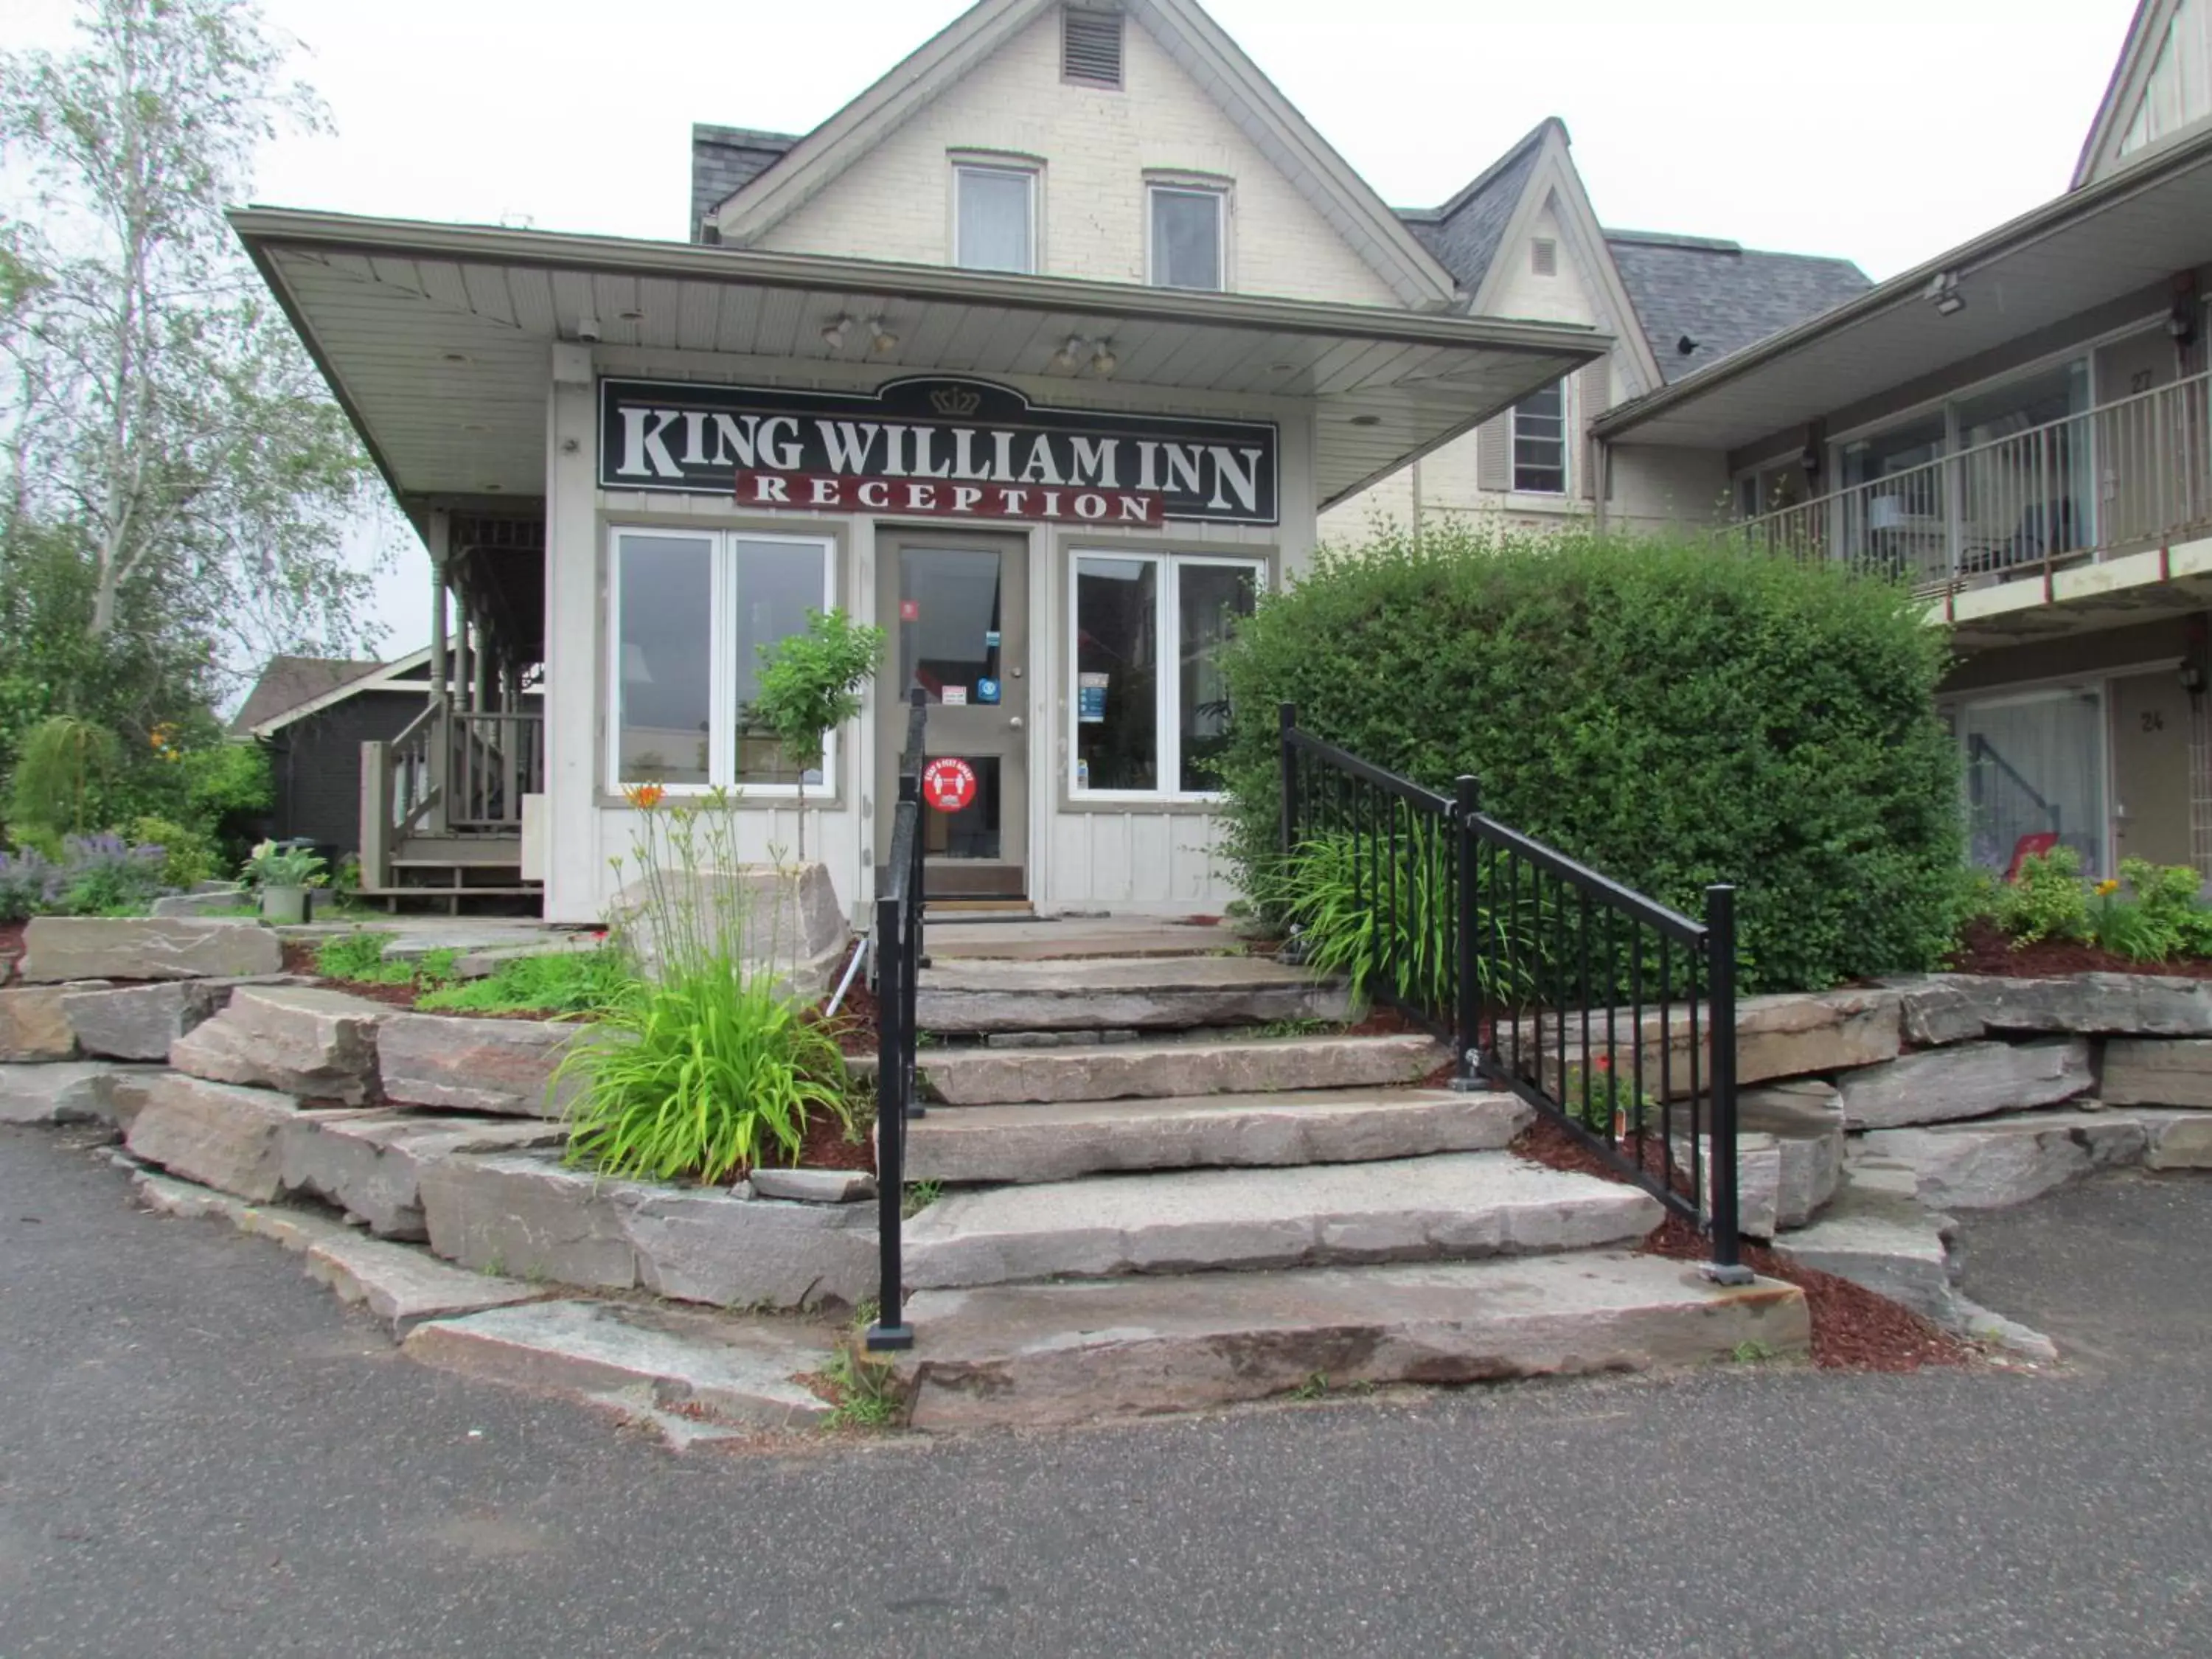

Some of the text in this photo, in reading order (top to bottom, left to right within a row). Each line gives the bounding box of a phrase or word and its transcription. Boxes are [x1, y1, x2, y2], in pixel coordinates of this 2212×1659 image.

[616, 407, 1263, 512] KING WILLIAM INN
[754, 476, 1151, 522] RECEPTION
